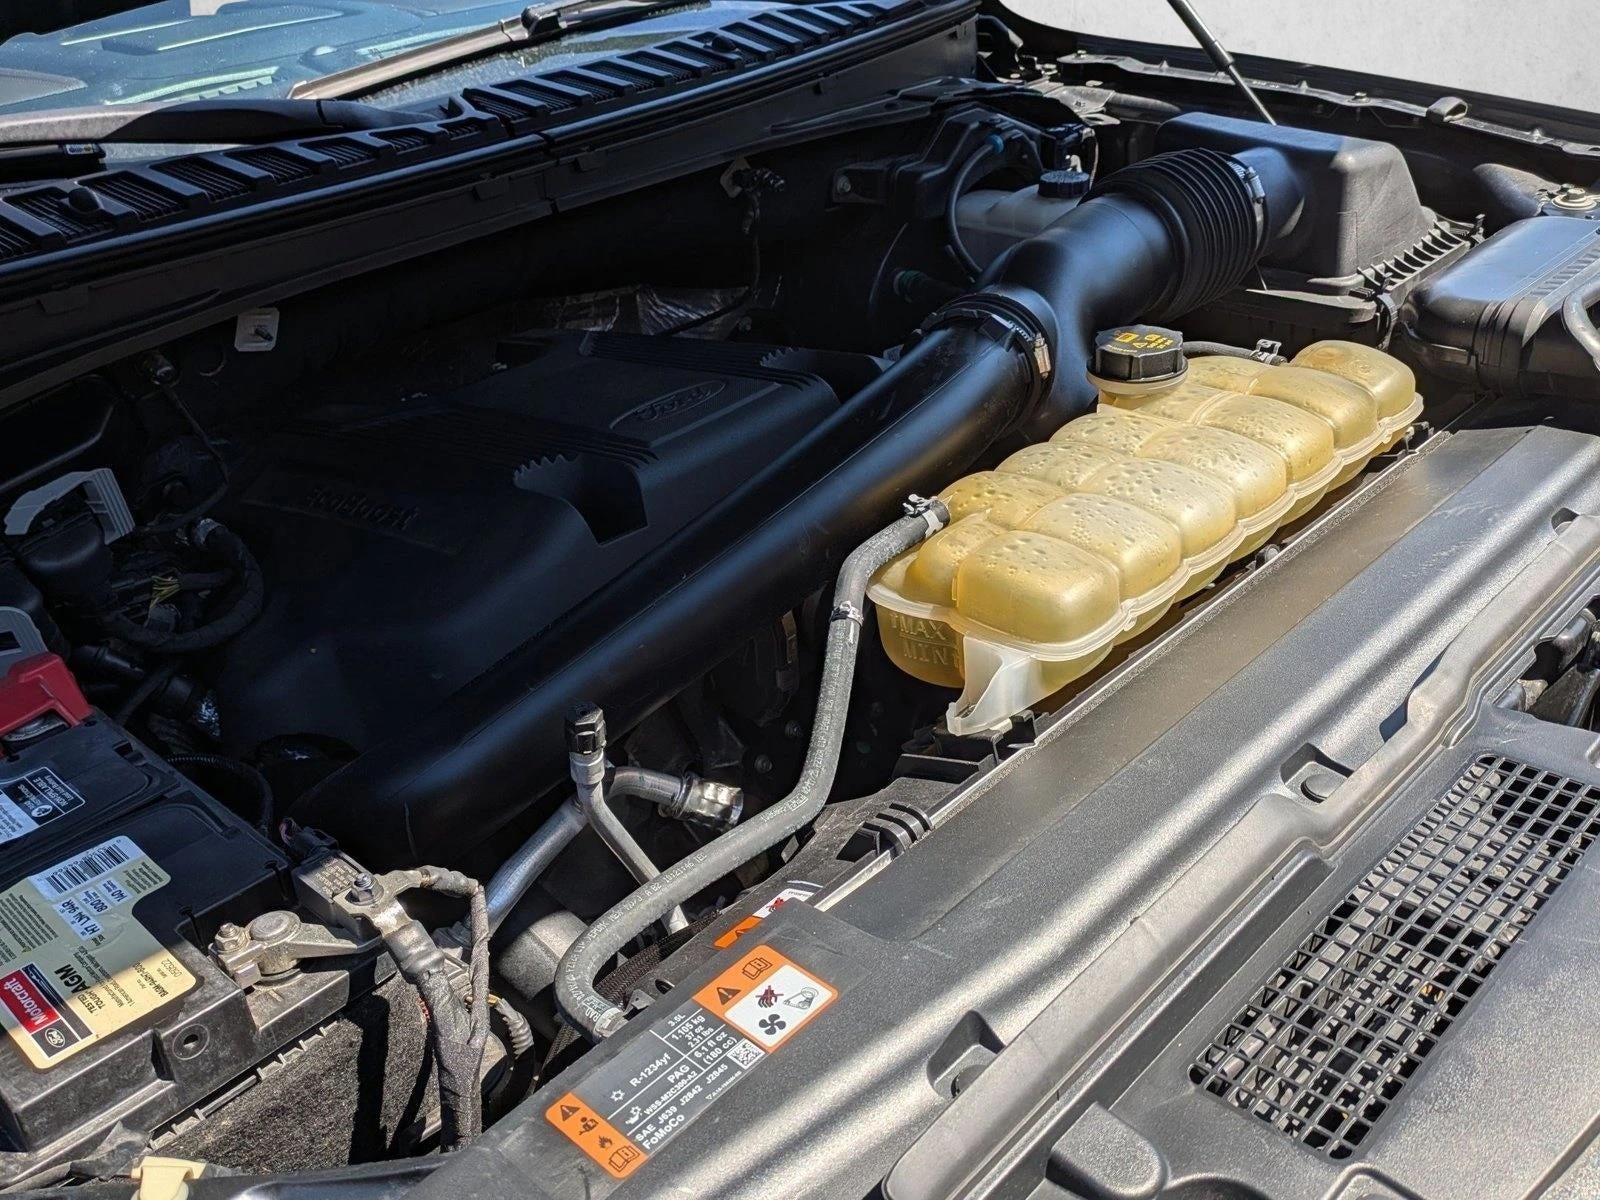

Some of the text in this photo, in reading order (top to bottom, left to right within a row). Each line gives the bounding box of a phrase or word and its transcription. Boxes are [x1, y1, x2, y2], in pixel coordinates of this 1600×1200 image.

[899, 616, 945, 641] MAX
[61, 898, 78, 914] 94R
[91, 899, 108, 912] 800
[111, 889, 127, 902] 140
[72, 910, 91, 925] LN4
[83, 922, 100, 935] H7
[54, 963, 90, 995] AGM
[4, 978, 48, 1025] Motorcraft
[77, 995, 96, 1014] TESTED
[667, 1012, 686, 1027] 3.5L
[671, 1015, 705, 1040] 1.105 kg
[684, 1025, 704, 1040] 37 oz
[687, 1027, 714, 1047] 2.31 lbs
[693, 1032, 728, 1058] 6.1 fl oz
[702, 1036, 738, 1065] (180 cc)
[629, 1052, 672, 1087] R-1234yf
[667, 1064, 690, 1083] PAG
[635, 1124, 656, 1142] SAE
[658, 1105, 678, 1124] J639
[679, 1085, 703, 1106] J2842
[705, 1063, 728, 1084] J2845
[644, 1070, 697, 1114] WSS-M2C300-A2
[642, 1114, 685, 1149] FoMoCo
